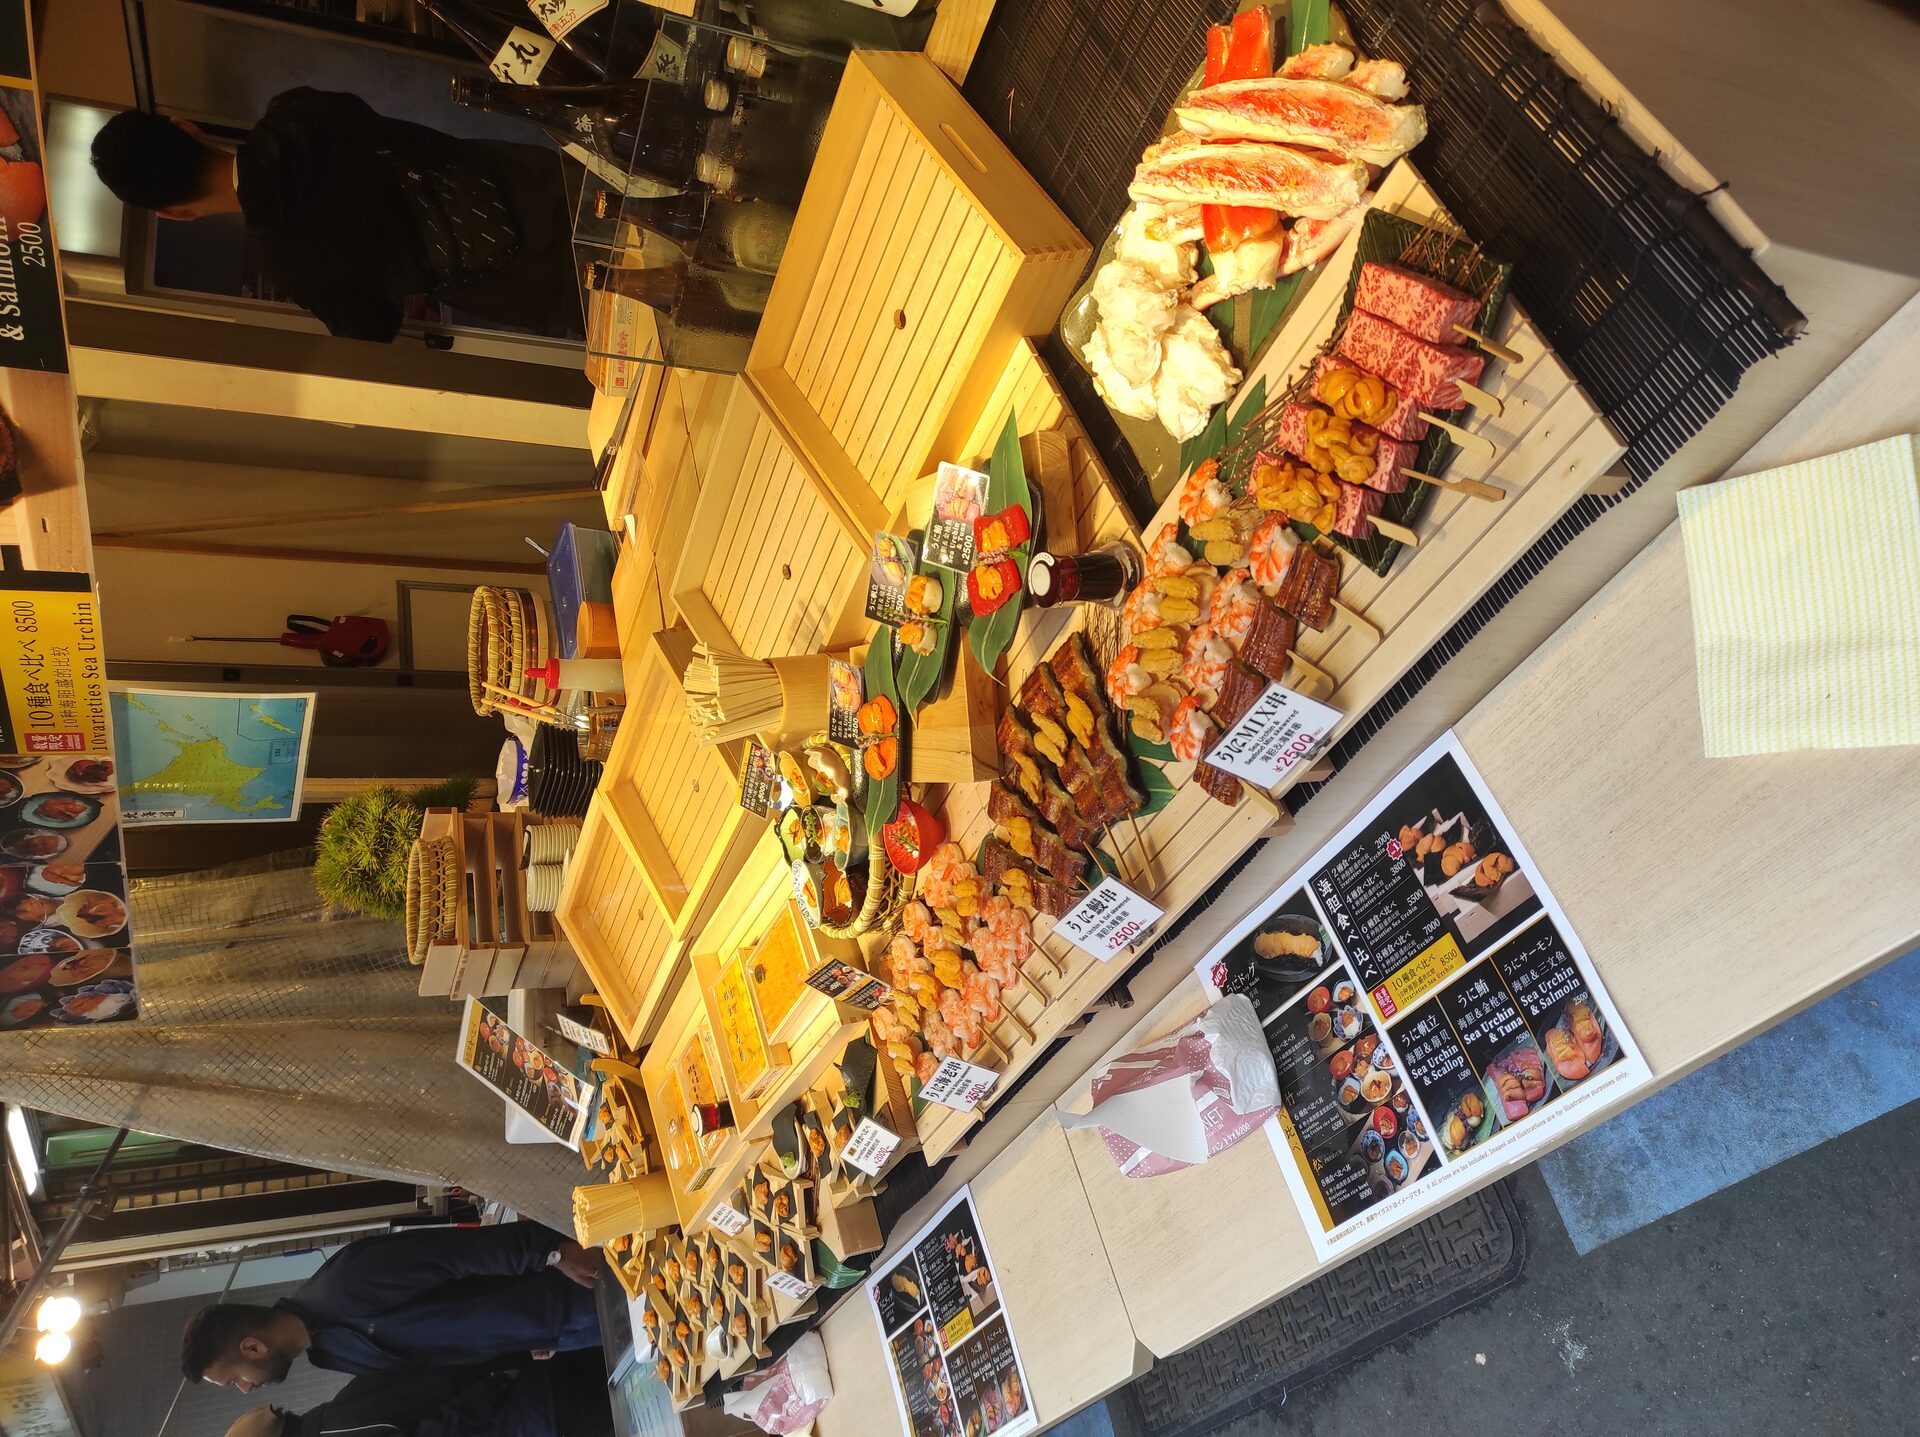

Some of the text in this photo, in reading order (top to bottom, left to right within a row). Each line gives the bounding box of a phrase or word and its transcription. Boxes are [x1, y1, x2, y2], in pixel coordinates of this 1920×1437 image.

[17, 221, 45, 267] 2500
[946, 521, 960, 563] Sea Urchin
[957, 522, 966, 541] Tuna
[11, 600, 54, 727] 10種食べ比べ 8500
[72, 602, 107, 750] 10varieties Sea Urchin
[50, 646, 78, 727] 10种海胆盛的比较
[1213, 689, 1292, 763] うにMIX串
[1244, 709, 1299, 765] Seafood Mix skewered
[1247, 742, 1260, 752] Sea
[1256, 724, 1276, 742] Urchin
[1331, 830, 1391, 878] 2種食べ比べ 2000
[1360, 859, 1370, 870] Sea
[1369, 846, 1386, 863] Urchin
[1344, 857, 1406, 905] 4種食べ比べ 3800
[1375, 887, 1385, 898] Sea
[1384, 873, 1401, 891] Urchin
[1315, 874, 1377, 982] 海胆食べ比べ
[1360, 887, 1424, 934] 6種食べ比べ 5500
[1391, 918, 1400, 928] Sea
[1400, 904, 1417, 921] Urchin
[1375, 917, 1441, 963] 8種食べ比べ 7000
[1407, 947, 1417, 957] Sea
[1416, 933, 1434, 950] Urchin
[1501, 932, 1556, 977] うにサーモン
[1213, 963, 1225, 985] NEW
[1390, 948, 1458, 991] 10種食べ比べ 8500
[1426, 975, 1436, 986] Sea
[1435, 961, 1454, 979] Urchin
[1519, 963, 1574, 1007] Sea Urchin
[1454, 976, 1490, 1010] うに鮪
[1529, 975, 1581, 1015] & Salmoln
[1572, 991, 1589, 1006] 2500
[1399, 1012, 1440, 1049] うに帆立
[1463, 1003, 1515, 1045] Sea Urchin
[1487, 1013, 1524, 1043] & Tuna
[1515, 1029, 1531, 1044] 2500
[1410, 1040, 1459, 1080] Sea Urchin
[1422, 1052, 1466, 1086] & Scallop
[1456, 1067, 1471, 1082] 1500
[1330, 1118, 1344, 1131] 6500
[1436, 1171, 1452, 1185] prices
[1451, 1167, 1460, 1176] are
[1459, 1162, 1468, 1171] tax
[1488, 1140, 1507, 1156] Images
[1505, 1134, 1516, 1145] and
[1545, 1112, 1555, 1122] are
[1553, 1107, 1564, 1117] for
[1589, 1077, 1616, 1098] purposes
[1310, 1155, 1324, 1173] 松
[1358, 1187, 1372, 1200] 8000
